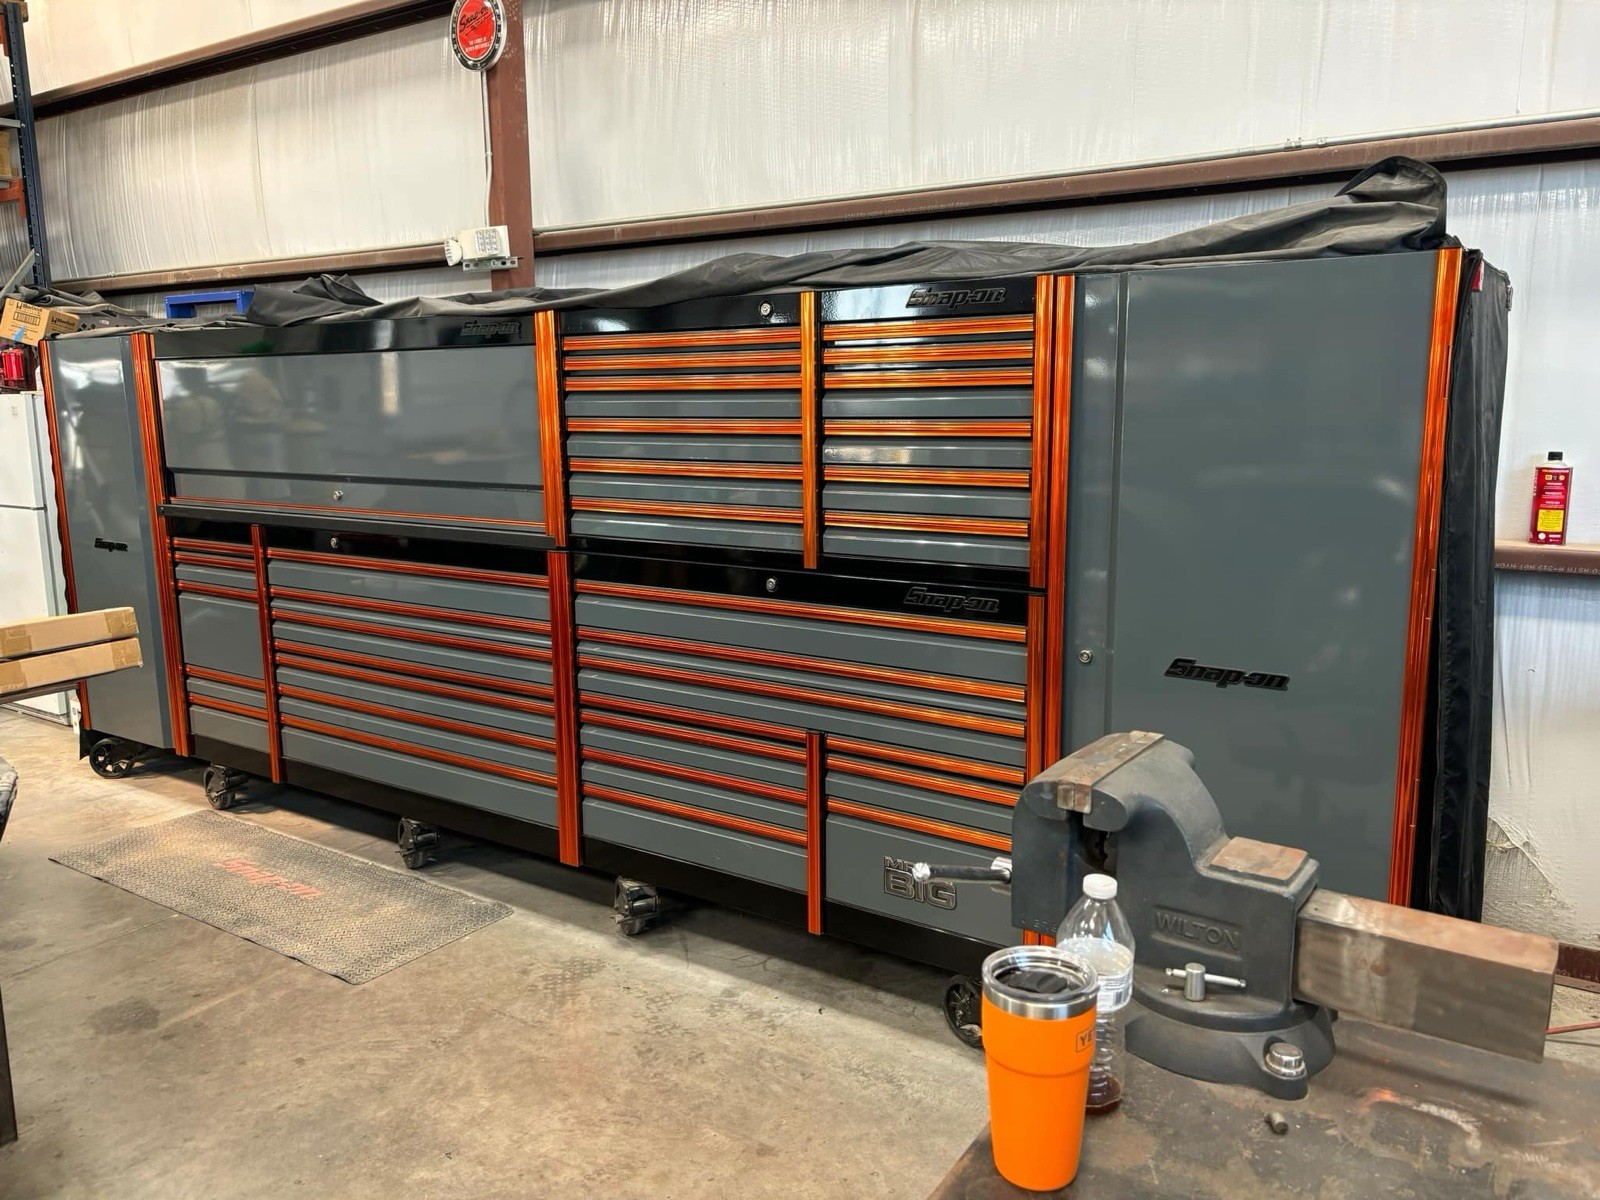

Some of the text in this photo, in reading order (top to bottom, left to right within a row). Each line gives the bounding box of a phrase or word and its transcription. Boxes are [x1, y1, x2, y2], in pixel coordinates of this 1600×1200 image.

[905, 287, 1006, 309] Snap-on
[903, 586, 999, 613] Snap-on
[1164, 657, 1290, 691] Snap-on
[884, 867, 957, 910] BIG
[1156, 911, 1240, 952] WILTON
